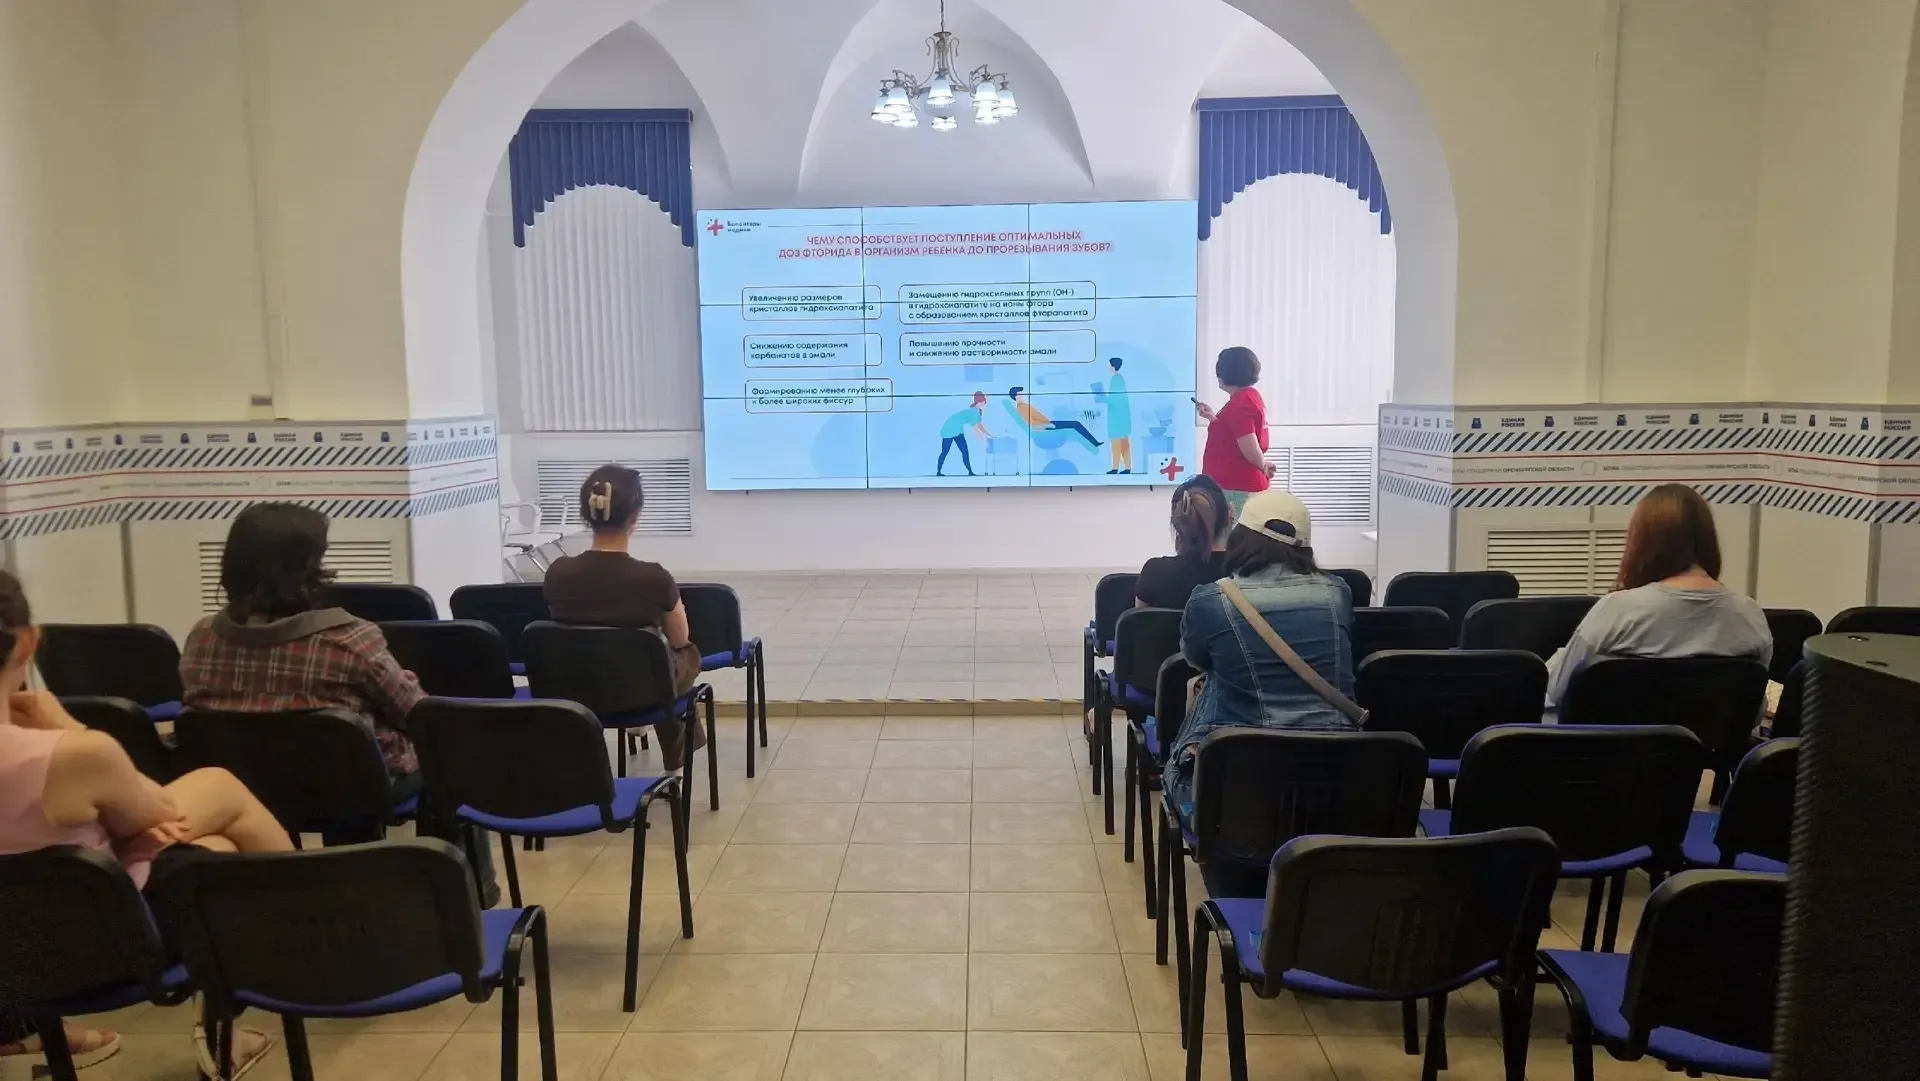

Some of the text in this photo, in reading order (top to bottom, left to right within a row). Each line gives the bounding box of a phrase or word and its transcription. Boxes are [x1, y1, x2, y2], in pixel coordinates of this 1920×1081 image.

[806, 231, 1081, 245] ЧЕМУ СПОСОБСТВУЕТ ПОСТУПЛЕНИЕ ОПТИМАЛЬНЫХ
[779, 242, 1111, 259] ДОЗ ФТОРИДА В ОРГАНИЗМ РЕБЕНКА ДО ПРОРЕЗЫВАНИЯ ЗУБОВ?
[749, 294, 843, 302] Увеличению размеров
[908, 291, 959, 299] Замещению
[961, 290, 1024, 298] гидроксильных
[1026, 289, 1051, 298] групп
[749, 304, 874, 313] кристаллов гидроксиапатита
[915, 302, 989, 310] гидроксиапатите
[1026, 300, 1054, 309] фтора
[915, 311, 978, 320] образованием
[980, 310, 1029, 319] кристаллов
[1032, 309, 1088, 318] фторапатита
[750, 342, 849, 350] Снижению содержания
[961, 339, 1006, 348] прочности
[750, 352, 801, 360] карбонатов
[961, 349, 1027, 358] растворимости
[1029, 348, 1057, 356] эмали
[751, 387, 818, 395] Формированию
[847, 387, 886, 395] глубоких
[758, 396, 784, 405] более
[785, 398, 821, 406] широких
[822, 397, 854, 406] фиссур
